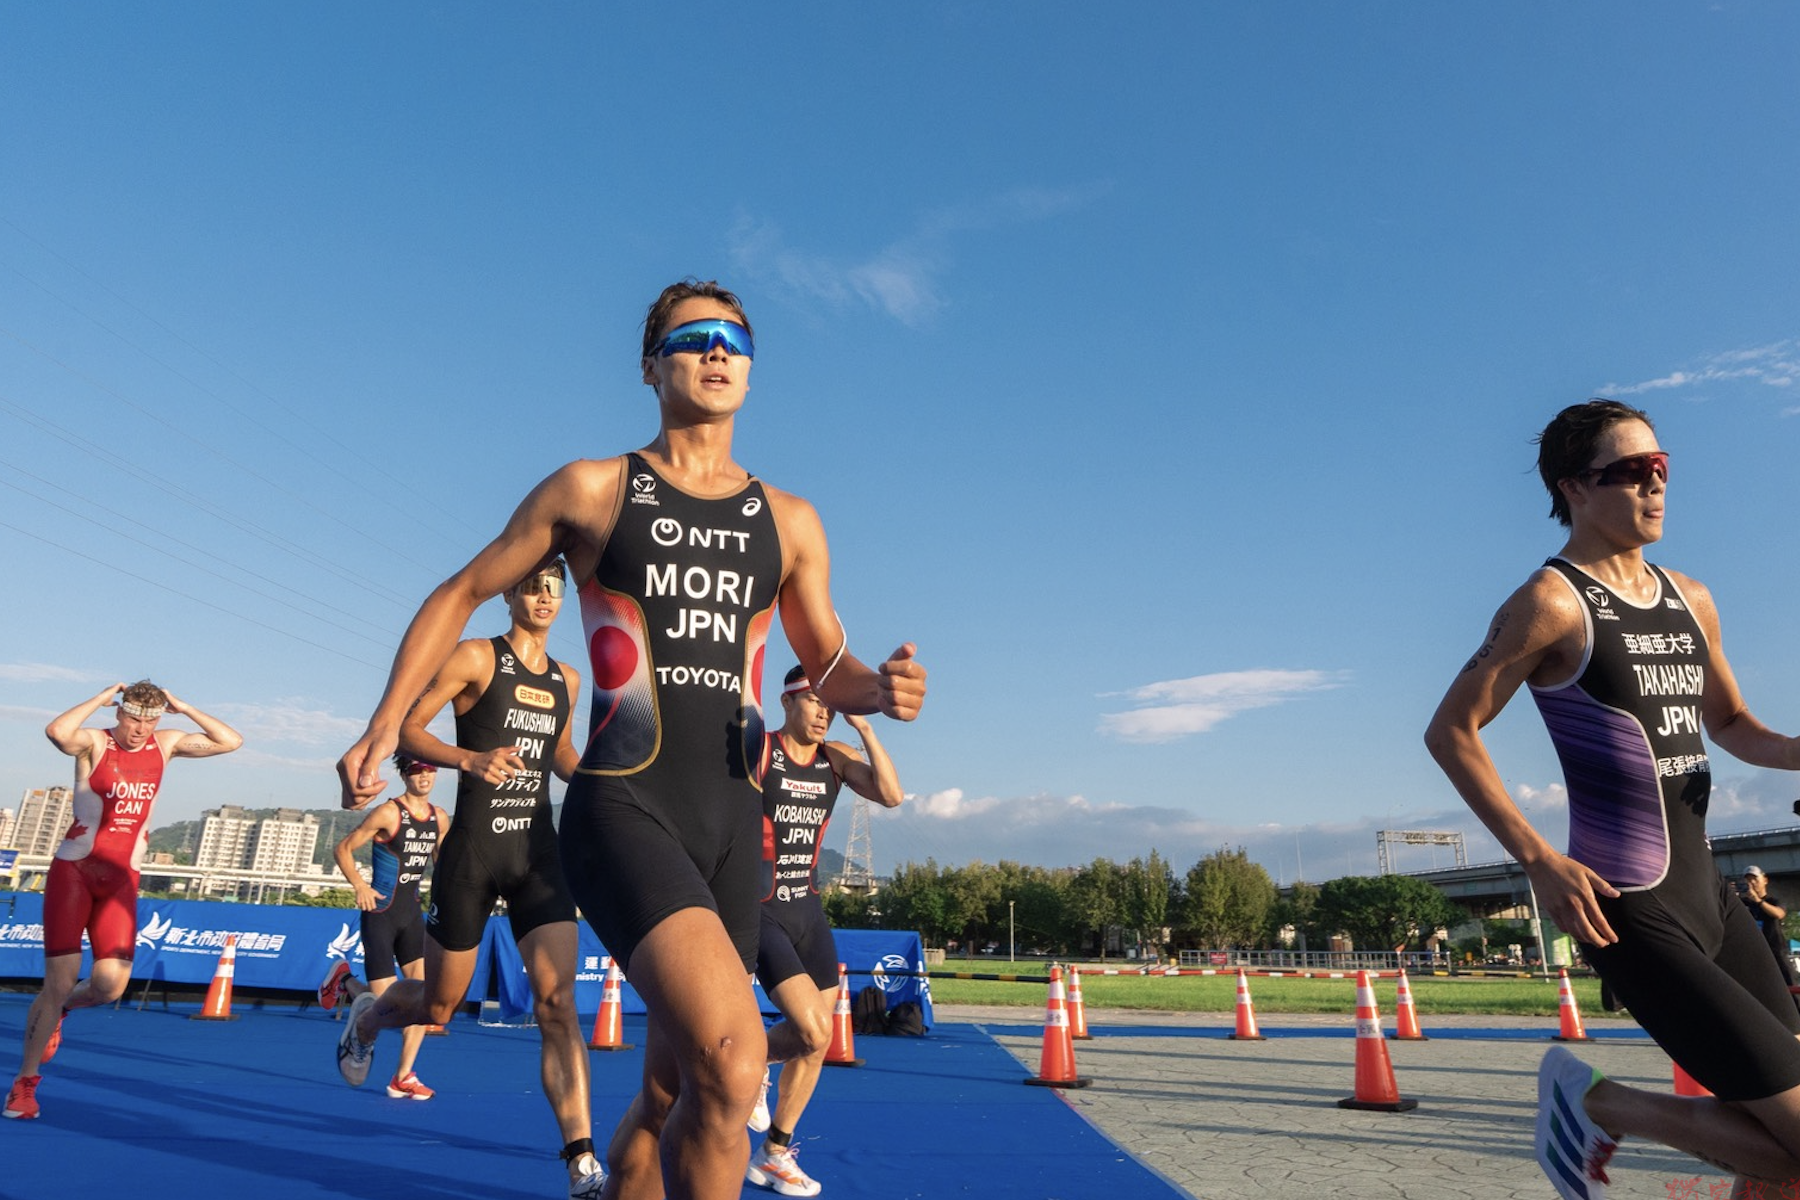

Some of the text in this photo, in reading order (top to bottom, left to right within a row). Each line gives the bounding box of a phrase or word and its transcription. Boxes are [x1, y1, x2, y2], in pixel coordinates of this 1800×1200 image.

[689, 526, 750, 553] NTT
[645, 563, 754, 608] MORI
[665, 608, 737, 644] JPN
[1621, 633, 1696, 655] 亜細亜大学
[656, 666, 742, 693] TOYOTA
[1632, 664, 1704, 697] TAKAHASHI
[503, 708, 557, 736] FUKUSHIMA
[1657, 705, 1699, 737] JPN
[105, 781, 156, 800] JONES
[786, 781, 822, 793] Yakult
[114, 800, 144, 815] CAN
[507, 817, 532, 831] NTT
[781, 827, 816, 845] JPN
[404, 855, 428, 867] JPN
[575, 971, 605, 983] nistry
